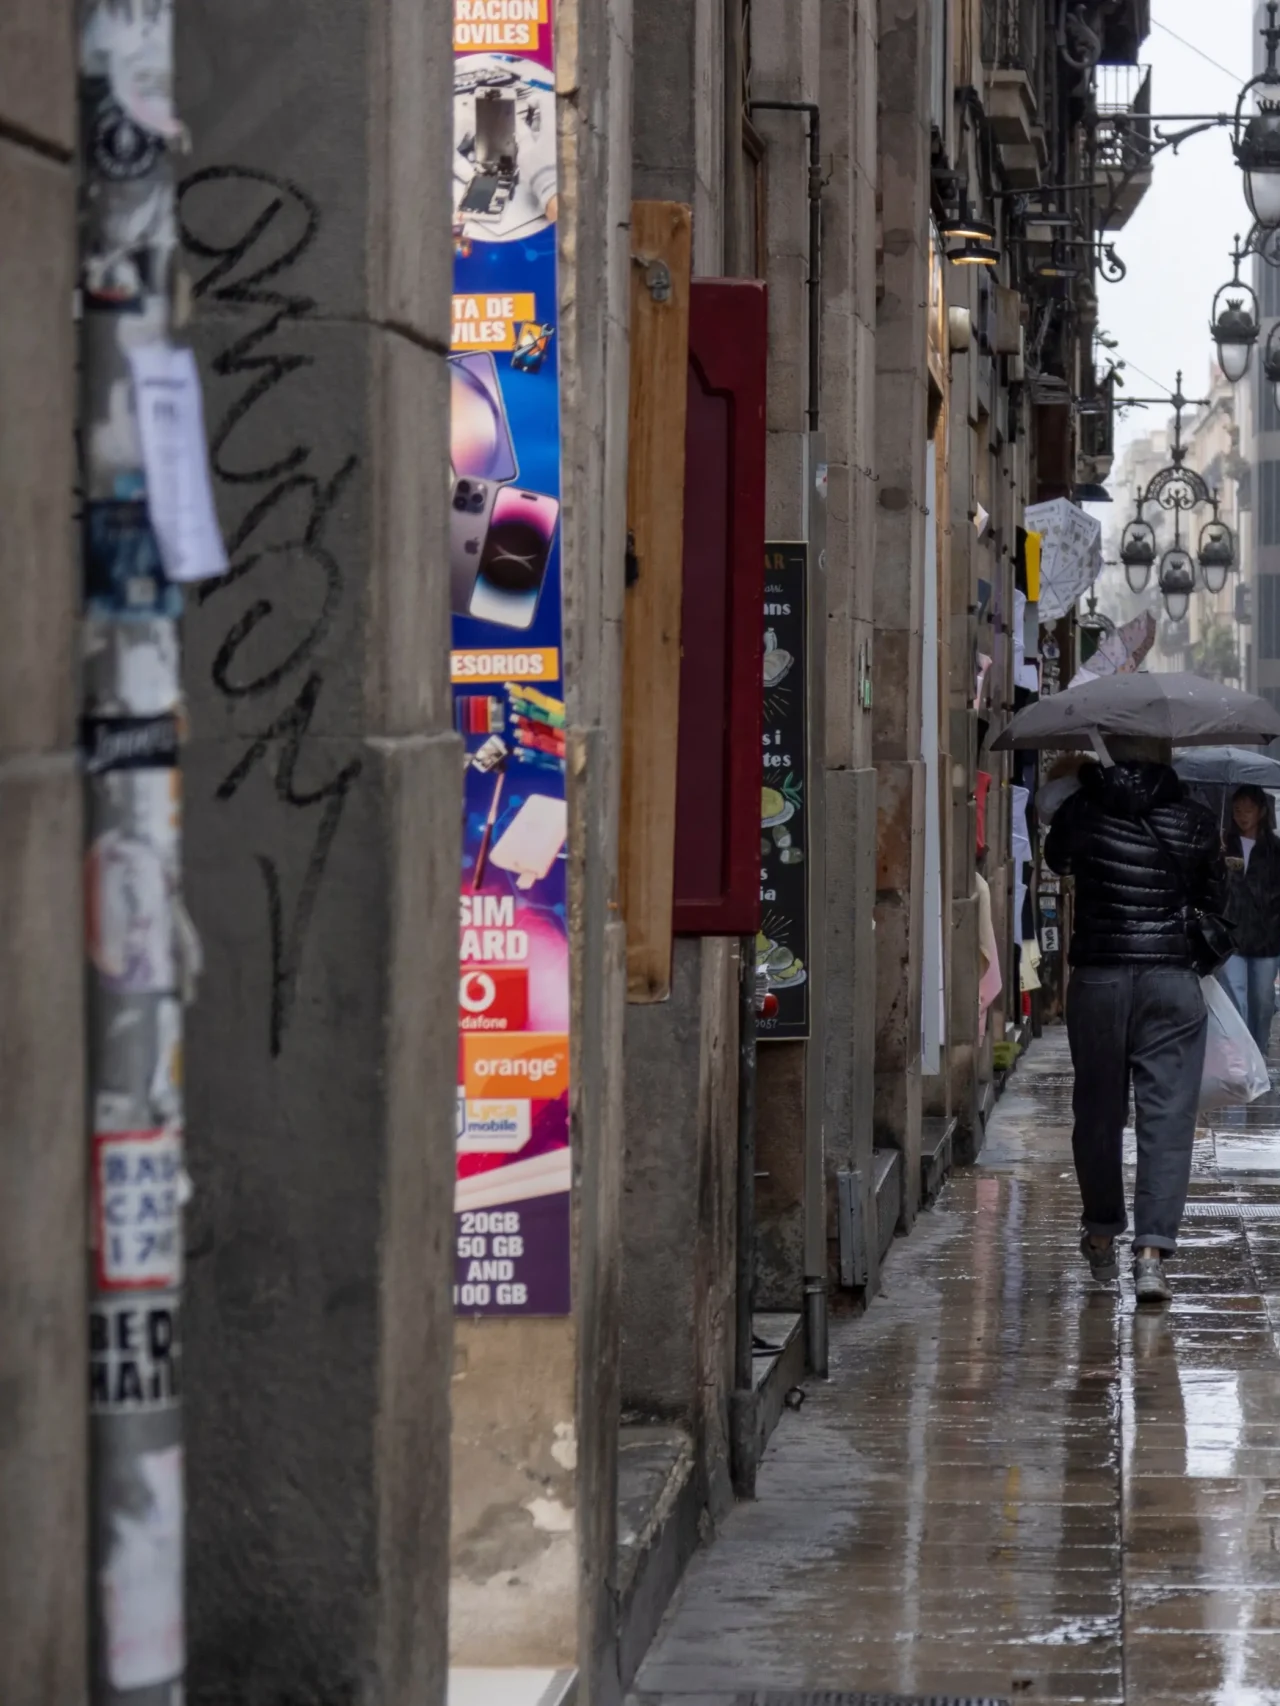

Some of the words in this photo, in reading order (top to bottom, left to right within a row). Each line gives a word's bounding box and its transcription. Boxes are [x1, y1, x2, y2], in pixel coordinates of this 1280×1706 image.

[455, 23, 529, 44] OVILES
[486, 297, 514, 318] DE
[451, 653, 543, 676] ESORIOS
[460, 895, 514, 927] SIM
[459, 929, 528, 961] ARD
[459, 1014, 507, 1029] dafone
[474, 1057, 557, 1081] orange
[466, 1101, 518, 1119] Lyca
[468, 1120, 517, 1132] mobile
[460, 1211, 520, 1234] 20GB
[457, 1236, 486, 1258] 50
[492, 1235, 524, 1258] GB
[467, 1260, 514, 1281] AND
[496, 1283, 527, 1305] GB
